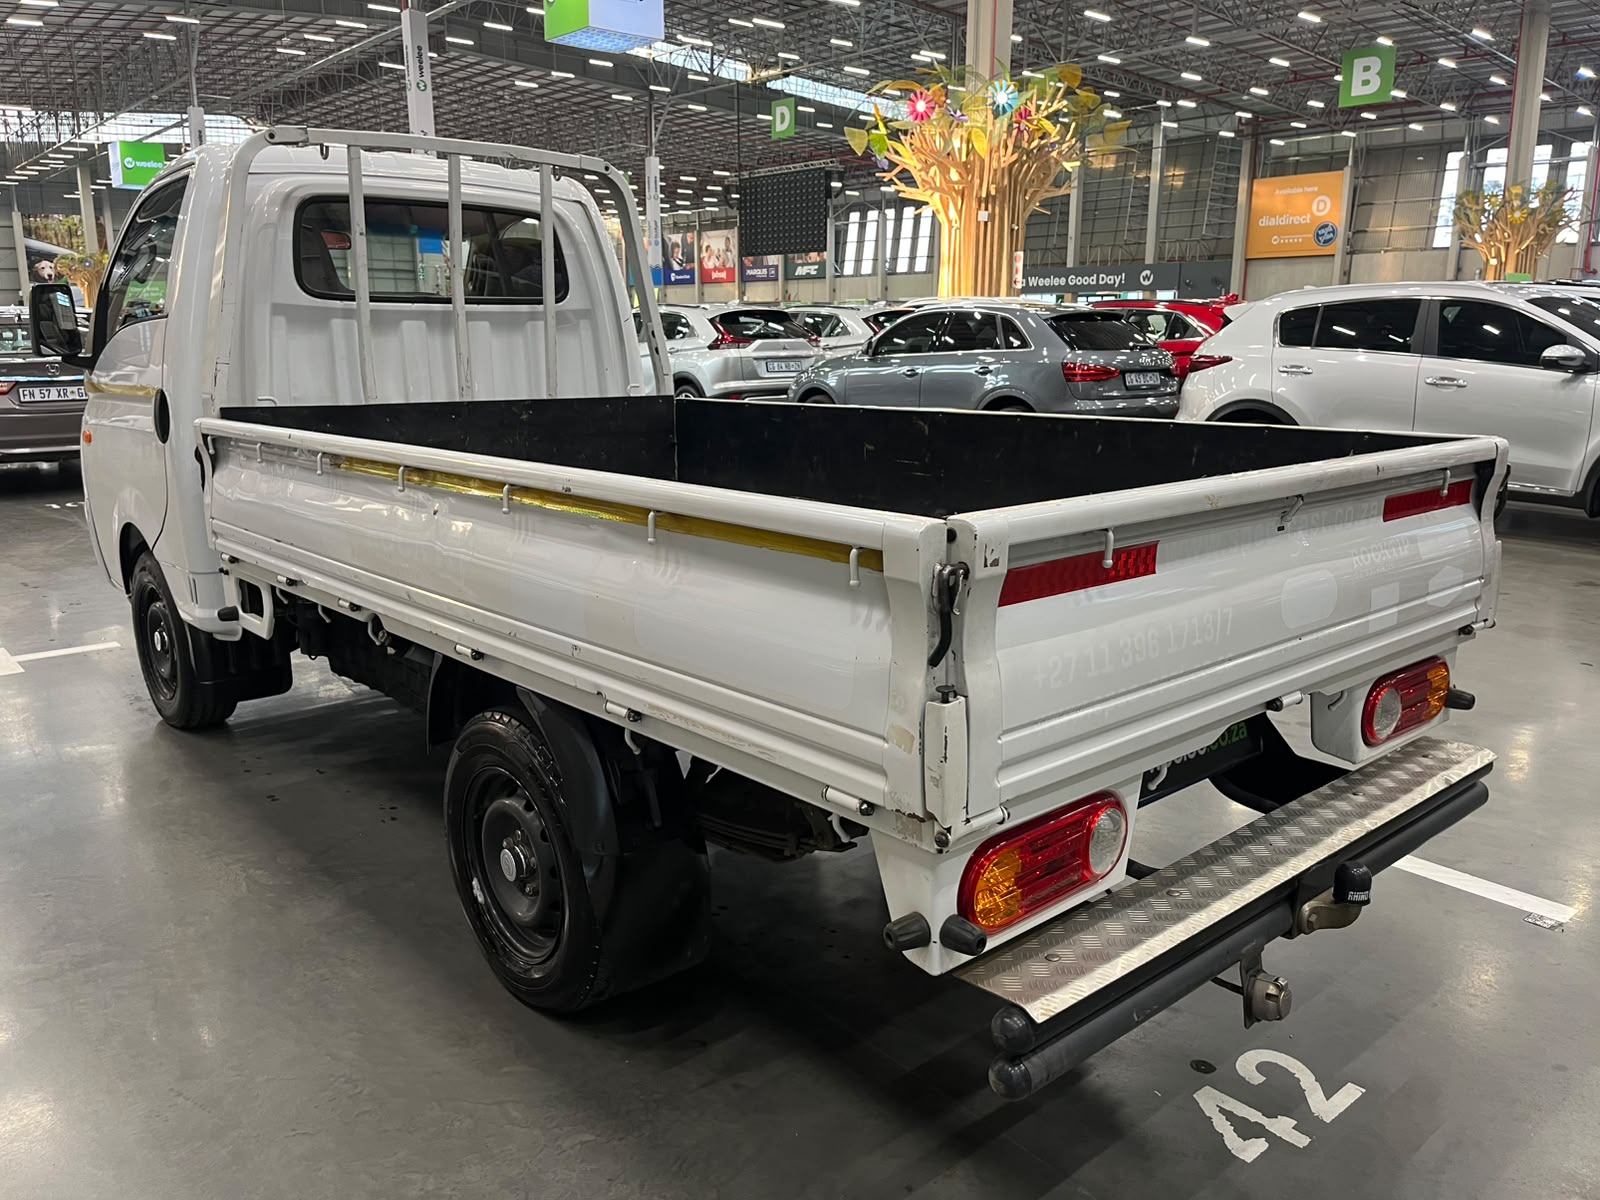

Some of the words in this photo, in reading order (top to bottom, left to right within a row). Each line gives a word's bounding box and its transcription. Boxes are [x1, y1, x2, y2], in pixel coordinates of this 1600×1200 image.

[1351, 56, 1382, 97] B
[775, 105, 791, 133] D
[1258, 213, 1311, 227] dialdirect
[1028, 275, 1066, 287] Weelee
[1068, 274, 1097, 286] Good
[1098, 272, 1126, 288] Day!
[22, 389, 35, 399] FN
[40, 388, 51, 399] 57
[56, 388, 69, 399] XR
[1085, 641, 1114, 678] 11
[1119, 627, 1160, 668] 396
[1347, 890, 1369, 902] RHINO
[1192, 1048, 1367, 1163] 42
